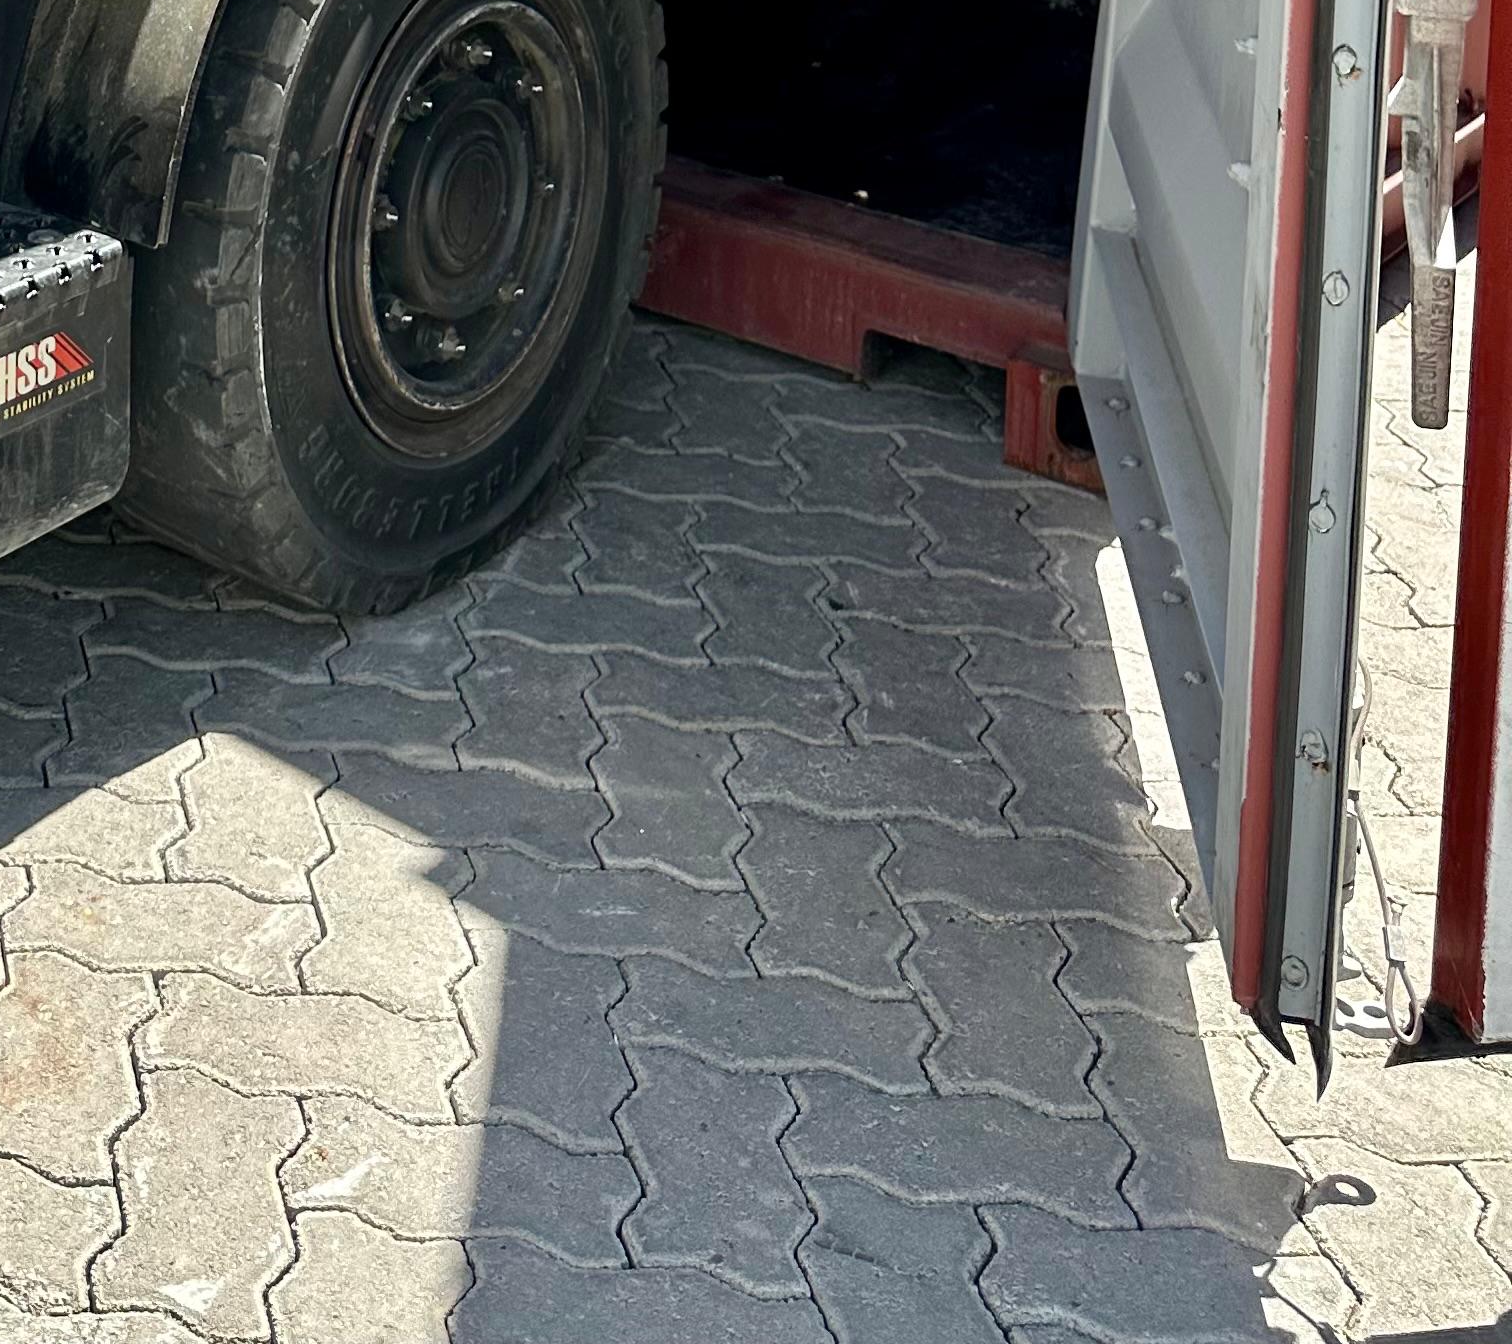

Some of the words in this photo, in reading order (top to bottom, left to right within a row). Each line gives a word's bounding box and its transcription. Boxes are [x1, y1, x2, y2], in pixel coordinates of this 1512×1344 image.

[3, 388, 54, 420] STABILITY
[57, 369, 95, 395] SYSTEM
[1416, 350, 1438, 422] SAEJIN
